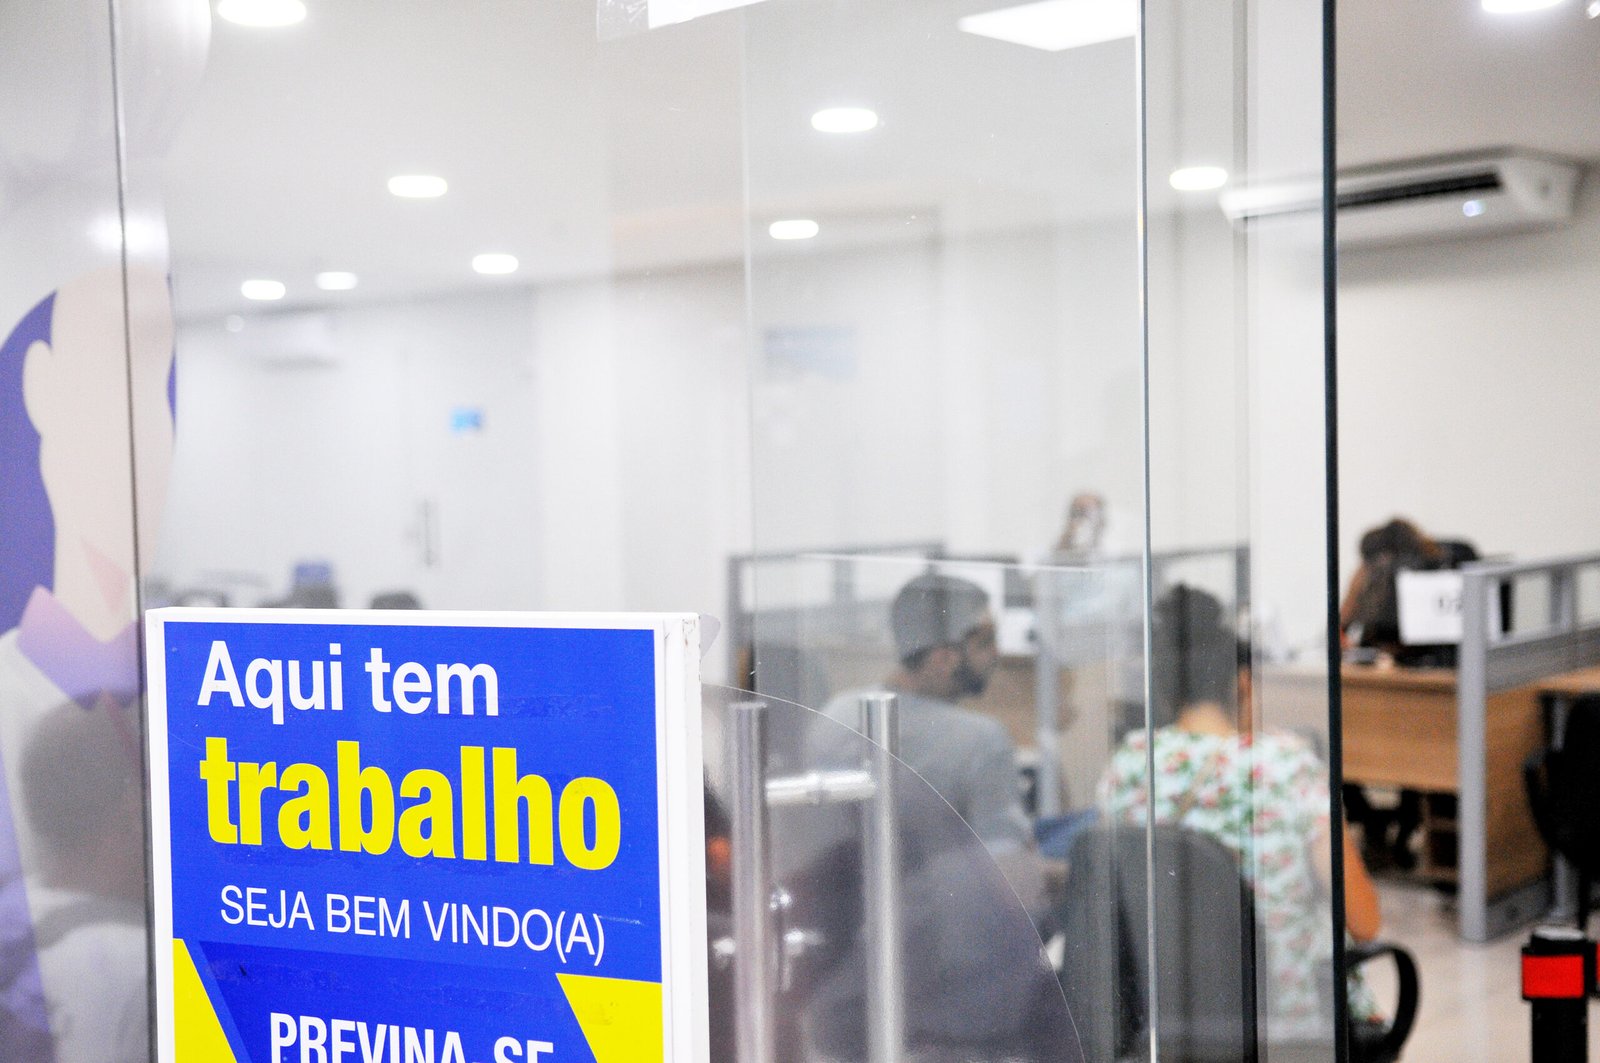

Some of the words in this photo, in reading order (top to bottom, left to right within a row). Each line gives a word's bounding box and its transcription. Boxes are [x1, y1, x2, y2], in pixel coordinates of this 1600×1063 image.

[197, 640, 344, 725] Aqui
[364, 647, 499, 717] tem
[199, 736, 621, 871] trabalho
[220, 884, 315, 931] SEJA
[326, 893, 411, 939] BEM
[422, 900, 605, 967] VINDO(A)
[270, 1012, 554, 1063] PREVINA
